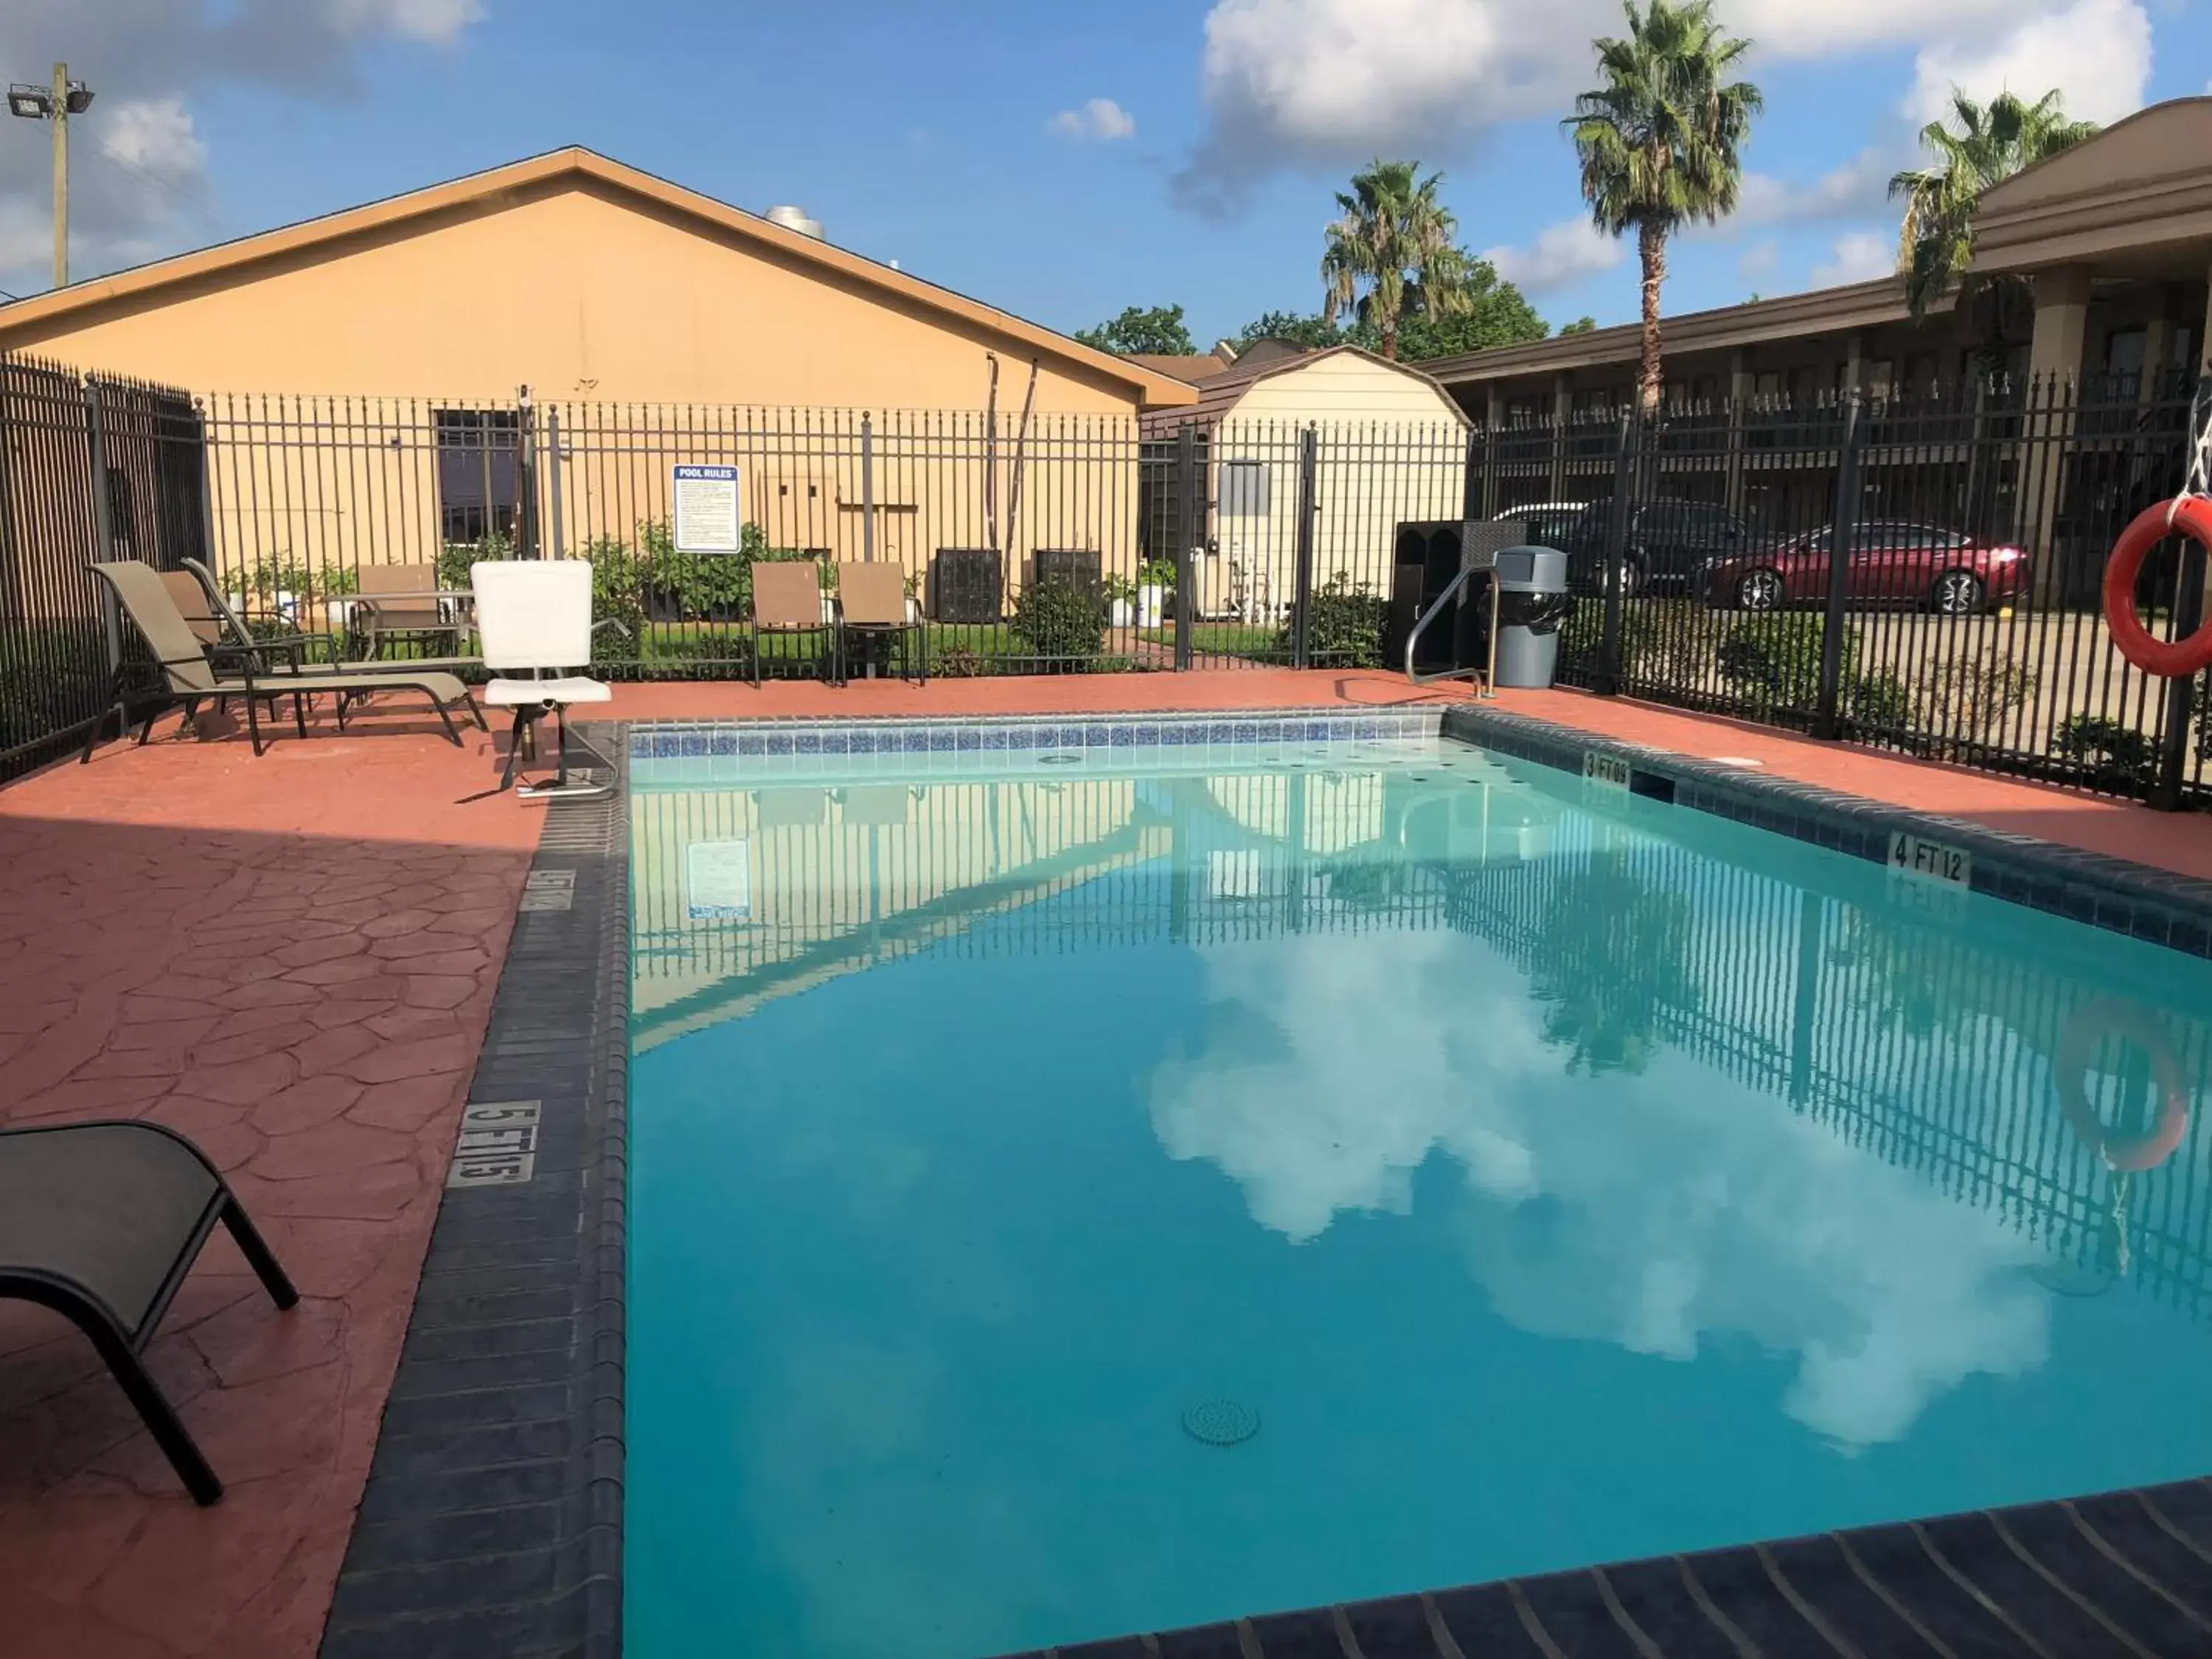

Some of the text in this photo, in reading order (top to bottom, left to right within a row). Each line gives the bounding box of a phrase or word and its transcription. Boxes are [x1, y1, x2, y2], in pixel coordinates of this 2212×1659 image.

[679, 467, 732, 479] POOL RULES
[1587, 753, 1594, 777] 3
[1599, 757, 1613, 780] FT
[1895, 835, 1906, 868] 4
[1915, 843, 1939, 874] FT
[467, 1108, 536, 1121] 5
[459, 1128, 532, 1150] FT
